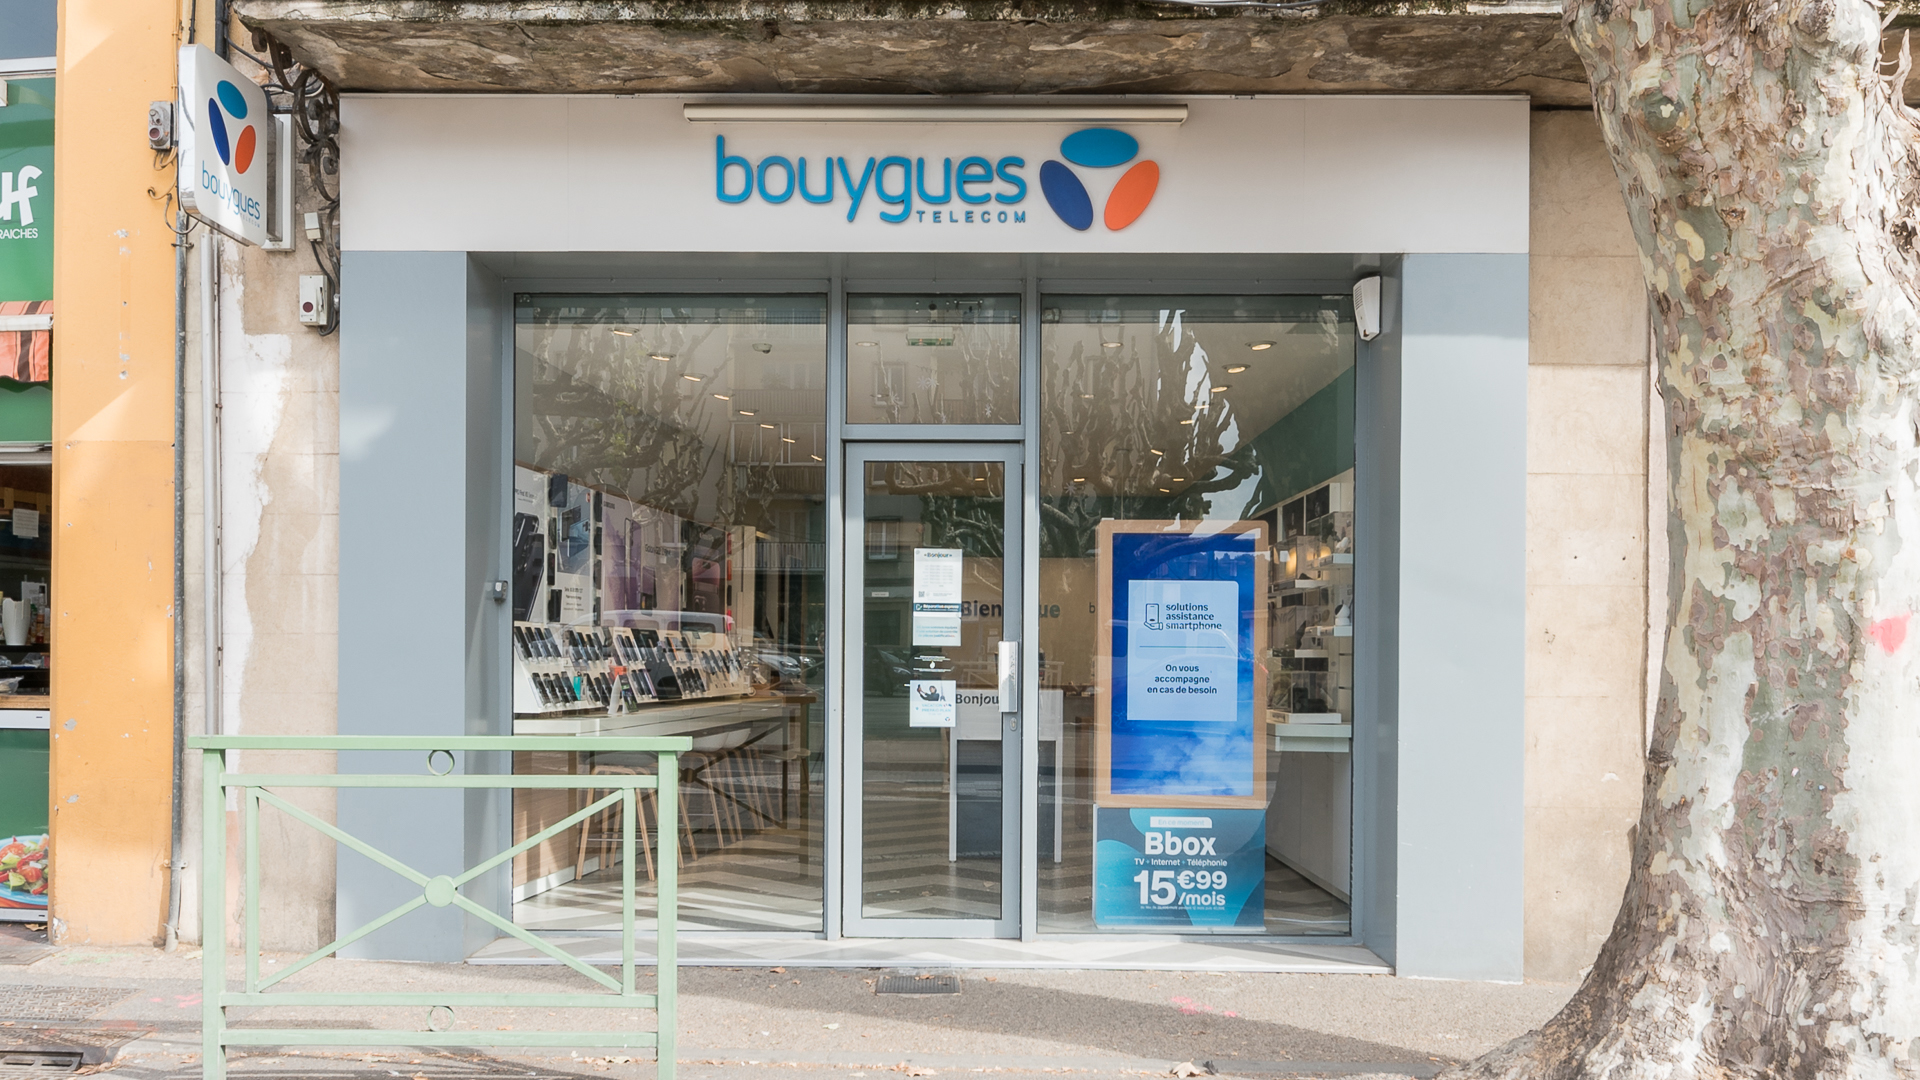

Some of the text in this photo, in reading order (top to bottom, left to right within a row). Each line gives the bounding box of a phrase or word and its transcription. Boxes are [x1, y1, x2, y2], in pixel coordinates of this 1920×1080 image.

[716, 134, 1027, 222] bouygues
[202, 159, 260, 220] bouygues
[916, 210, 1026, 223] TELECOM
[1165, 602, 1209, 611] solutions
[1165, 612, 1215, 621] assistance
[1165, 622, 1223, 631] smartphone
[1165, 664, 1178, 672] On
[1154, 676, 1210, 684] accompagne
[1147, 685, 1218, 694] en cas de besoin
[955, 693, 1000, 707] Bonjou
[1145, 831, 1217, 856] Bbox
[1134, 858, 1145, 866] TV
[1151, 858, 1180, 866] Internet
[1186, 859, 1228, 868] Téléphonie
